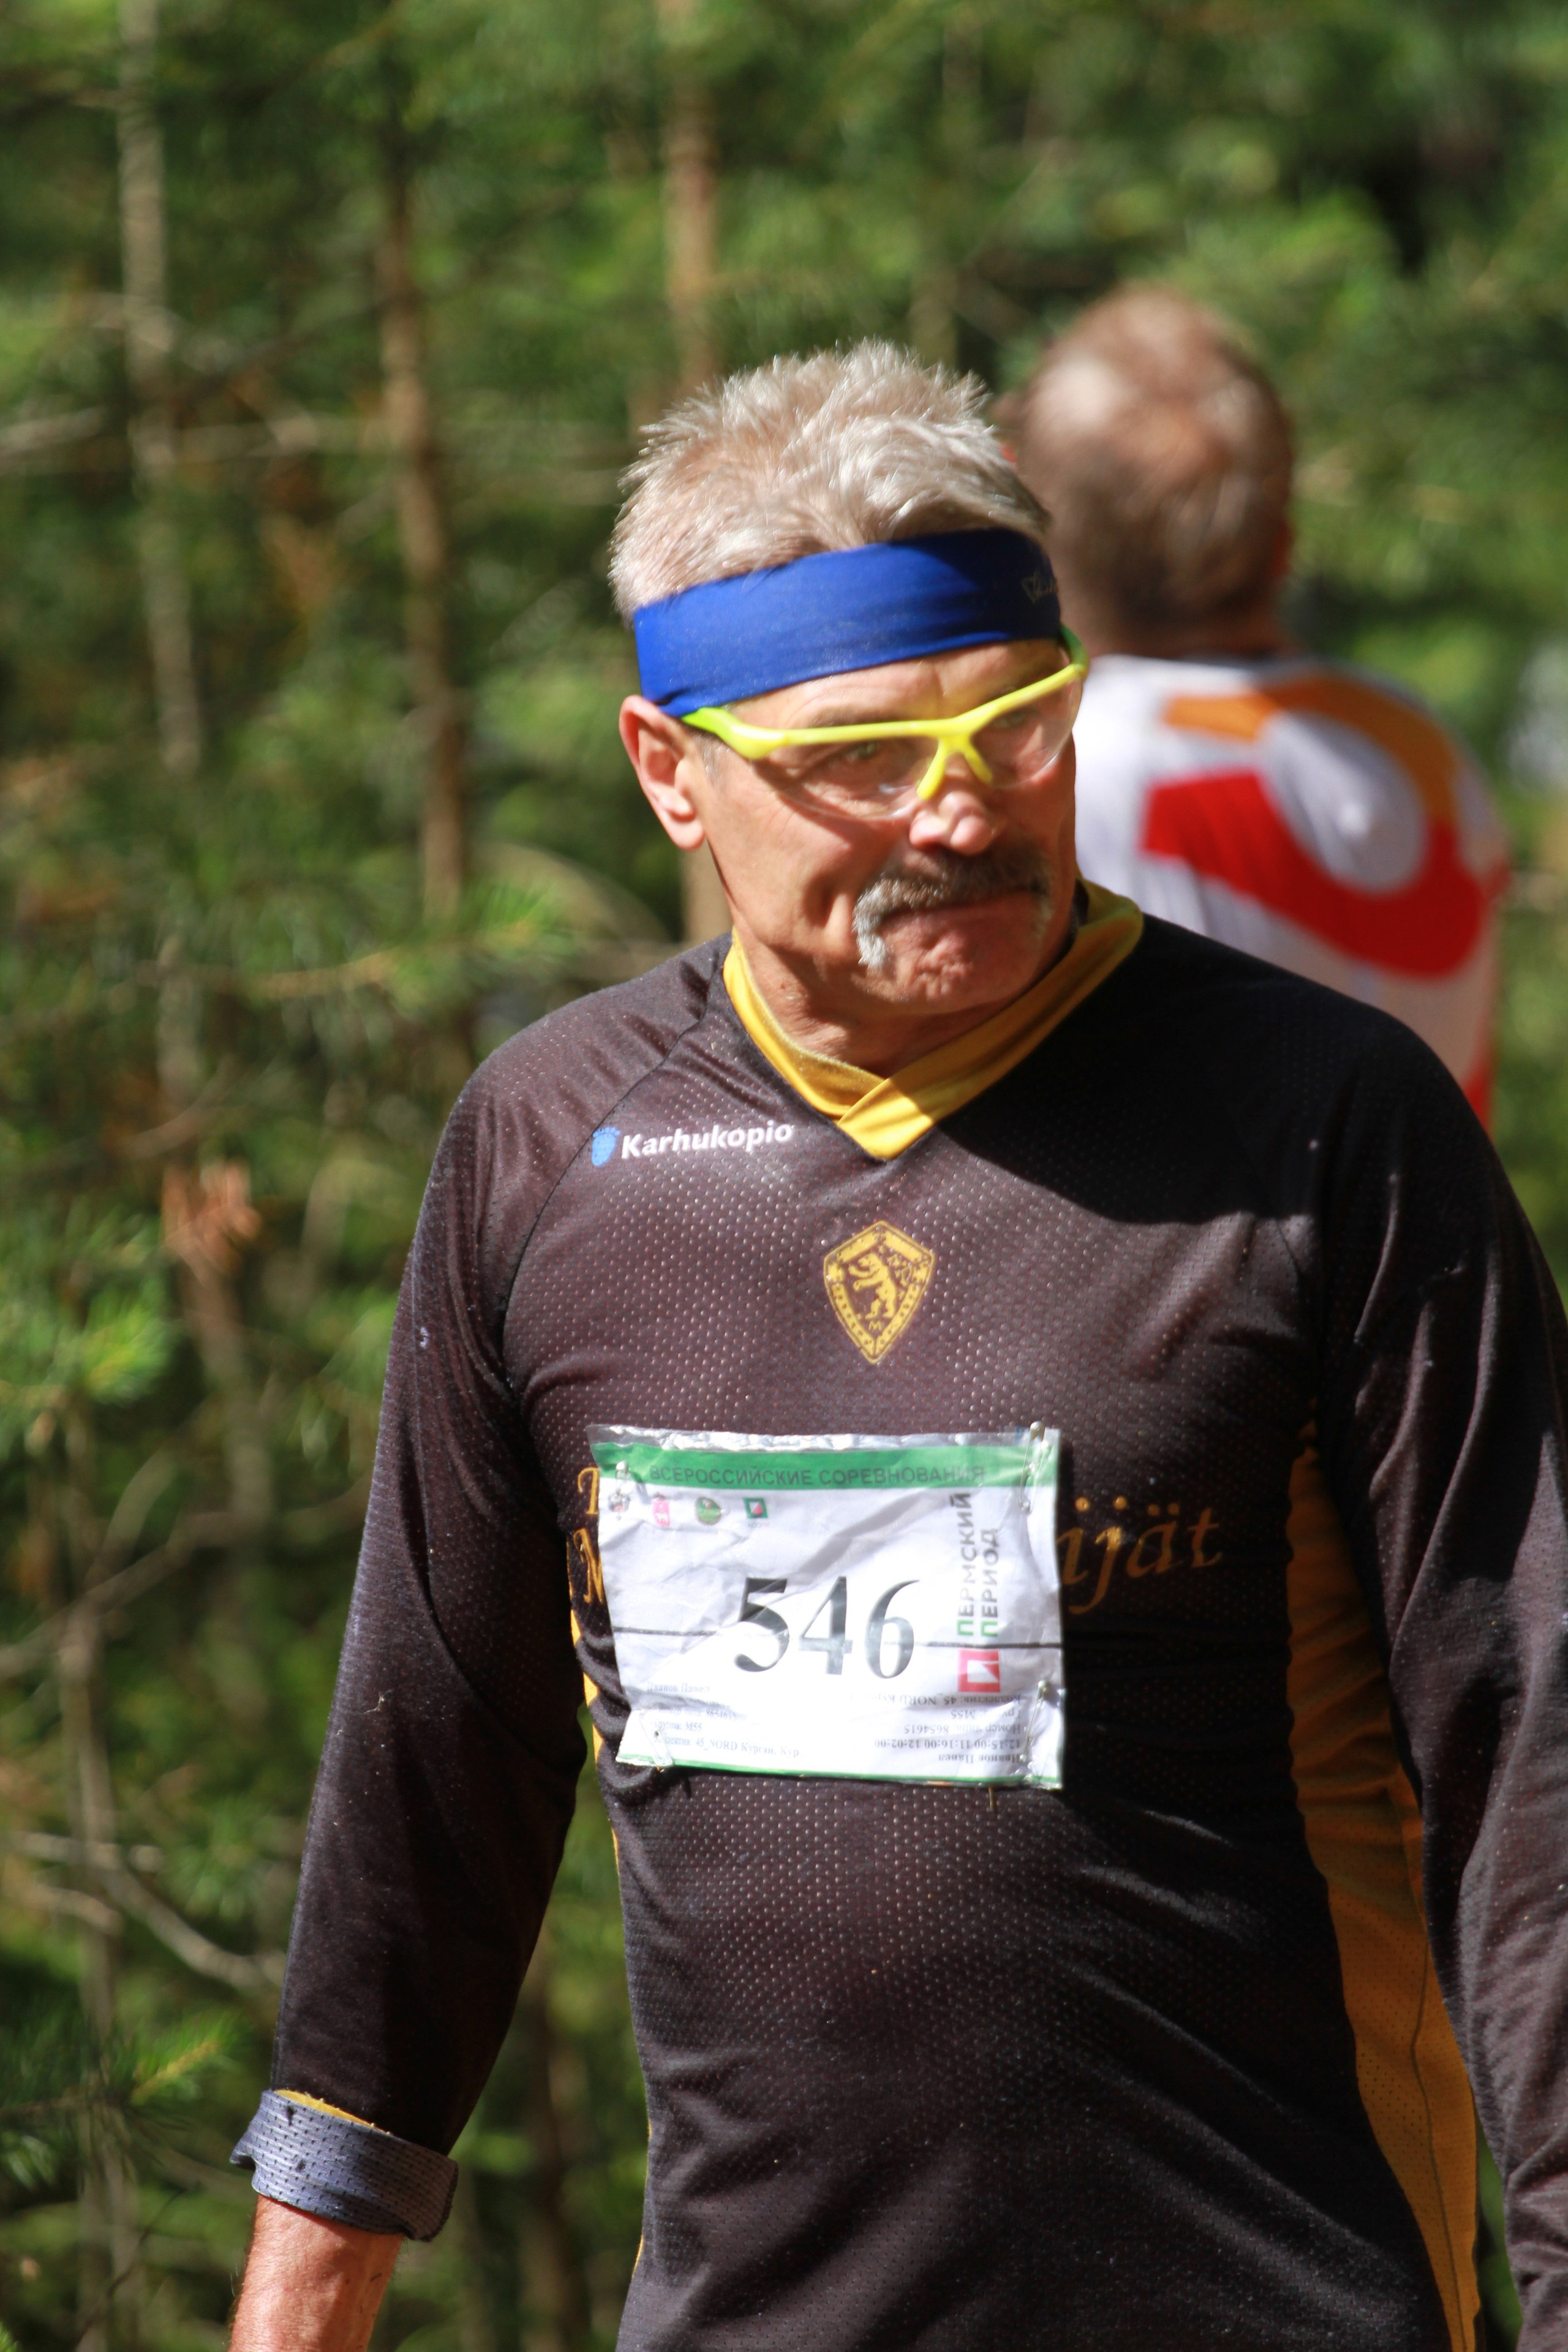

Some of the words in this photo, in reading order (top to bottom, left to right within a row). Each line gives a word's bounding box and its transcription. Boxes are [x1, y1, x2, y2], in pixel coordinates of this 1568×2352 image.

[622, 1120, 794, 1159] Karhukopio
[649, 1464, 813, 1485] ВСЕРОССИЙСКИЕ
[819, 1466, 985, 1485] СОРЕВНОВАНИЯ
[950, 1492, 976, 1636] ПЕРМСКИЙ
[980, 1529, 1000, 1637] ПЕРИОД
[734, 1575, 921, 1679] 546
[647, 1681, 679, 1692] Иванов
[903, 1724, 949, 1735] 8654615
[986, 1724, 1020, 1735] Номер
[695, 1738, 738, 1751] 45_NORD
[874, 1738, 920, 1749] 12:02:00
[924, 1740, 970, 1749] 11:16:00
[974, 1739, 1020, 1749] 12:15:00
[938, 1754, 974, 1764] Павел
